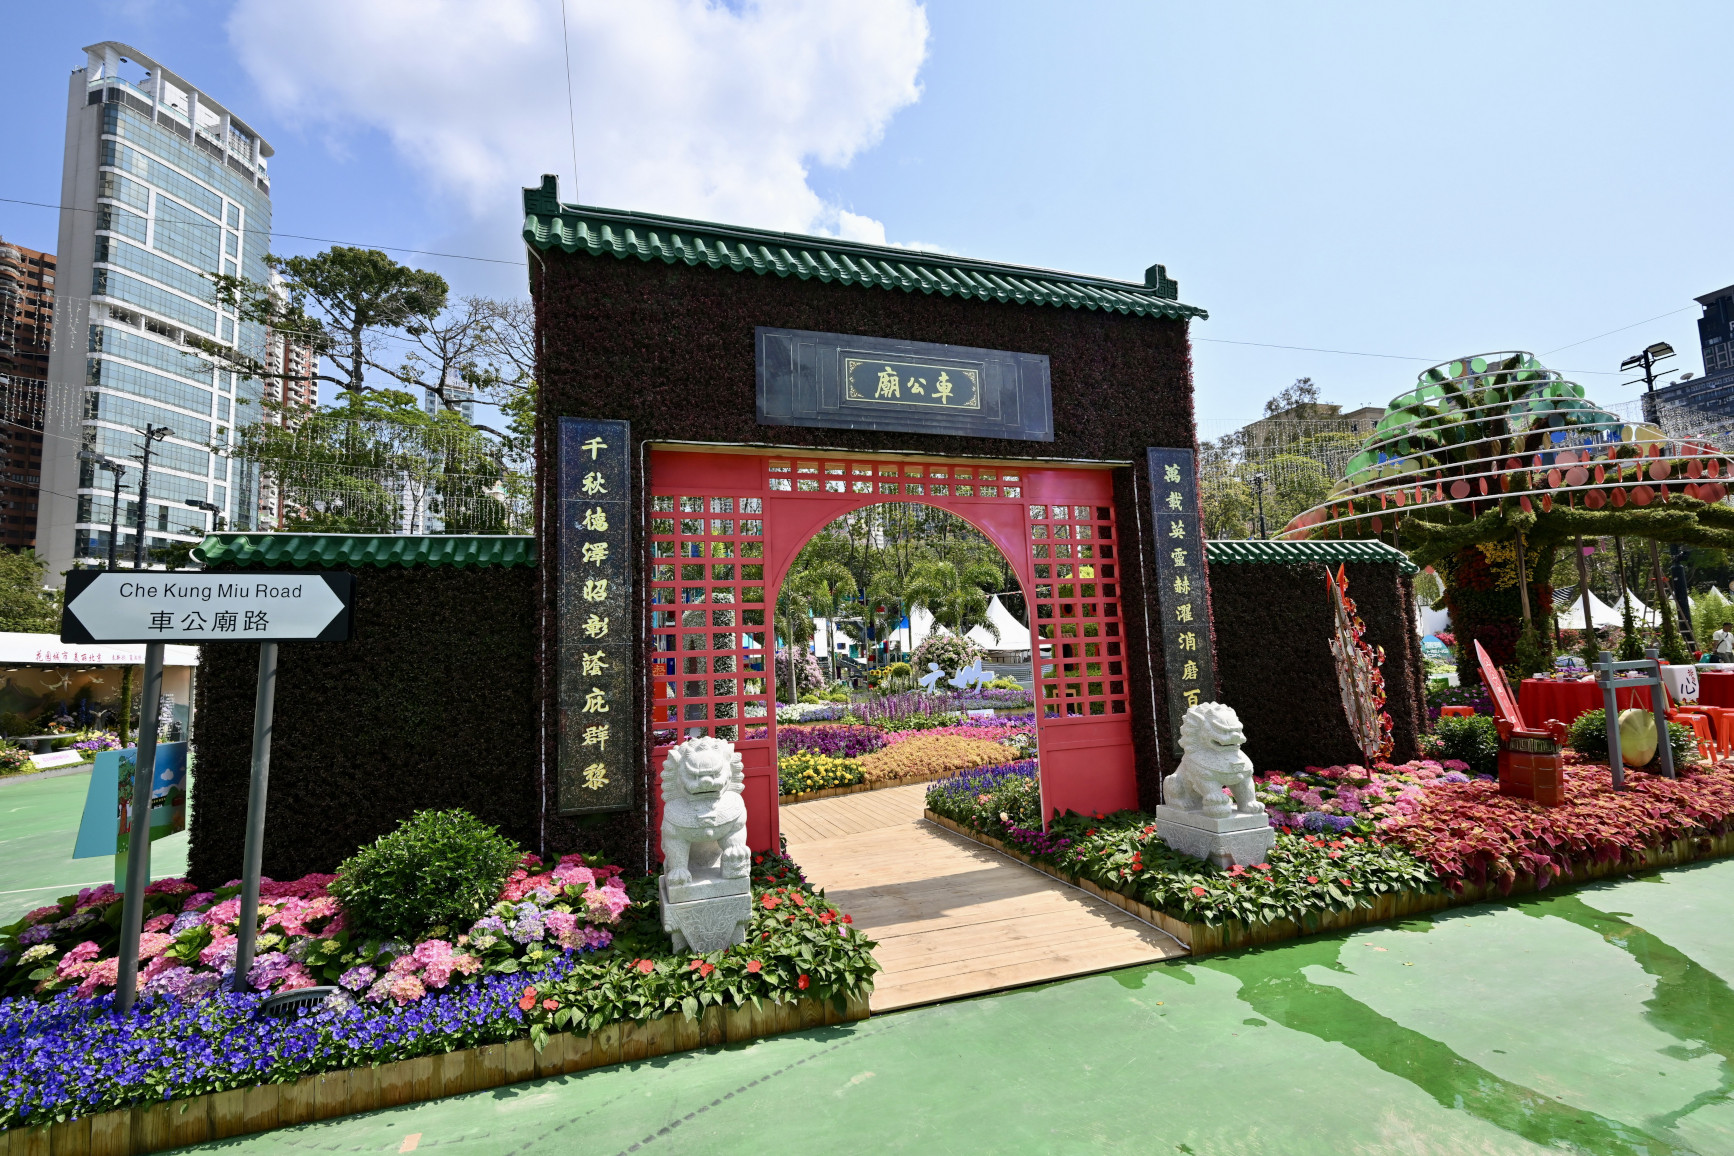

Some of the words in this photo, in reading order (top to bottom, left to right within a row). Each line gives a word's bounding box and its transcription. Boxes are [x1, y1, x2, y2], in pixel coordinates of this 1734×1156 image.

[875, 366, 954, 404] 車公廟
[119, 583, 158, 598] Che
[164, 583, 212, 601] Kung
[217, 584, 249, 598] Miu
[255, 584, 302, 598] Road
[147, 610, 270, 633] 車公廟路
